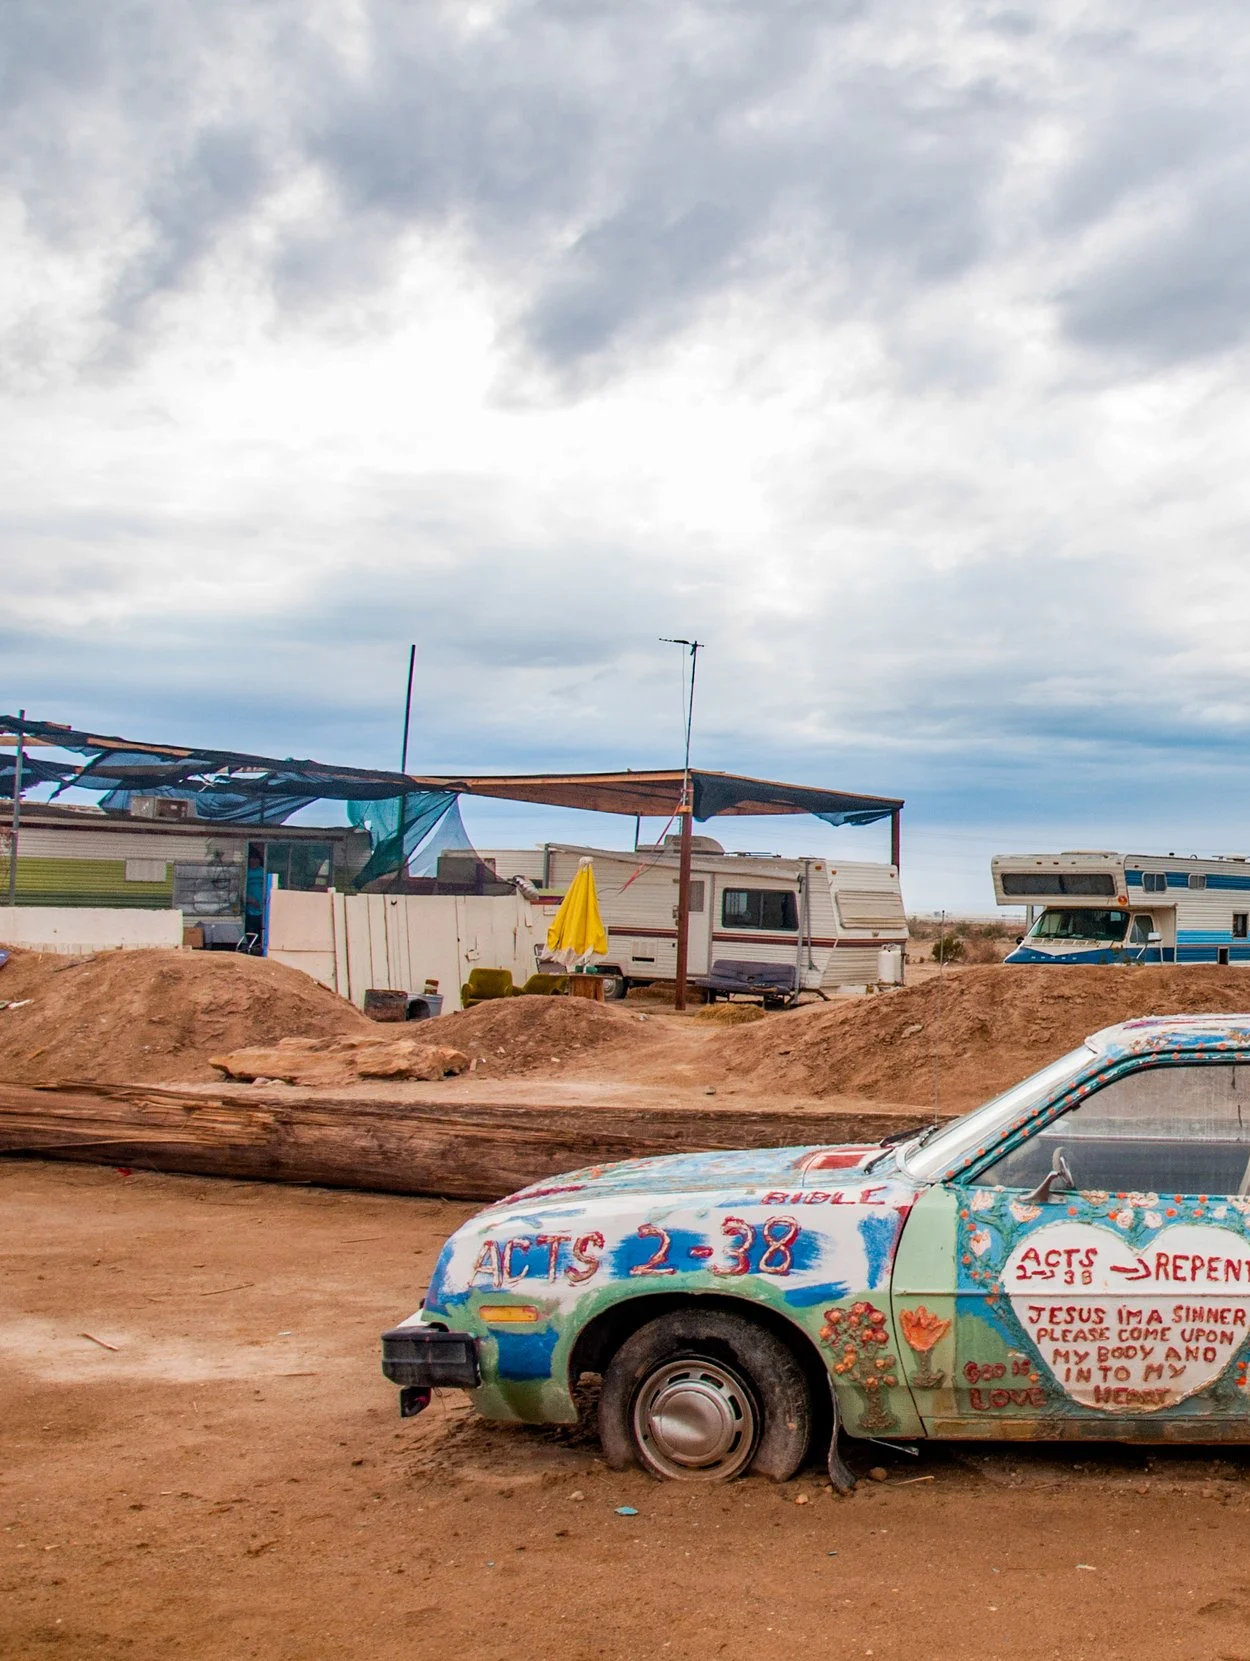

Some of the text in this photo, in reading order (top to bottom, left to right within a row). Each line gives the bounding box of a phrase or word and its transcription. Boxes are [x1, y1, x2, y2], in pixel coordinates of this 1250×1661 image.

[759, 1185, 887, 1206] BIBLE
[467, 1231, 605, 1288] ACTS
[1020, 1247, 1098, 1268] ACTS
[1028, 1305, 1106, 1325] JESUS
[1172, 1304, 1247, 1327] SINNER
[1036, 1326, 1235, 1346] PLEASE COME UPON
[1052, 1345, 1217, 1366] MY BODY AND
[963, 1359, 1032, 1384] GOD IS
[1143, 1363, 1187, 1383] MY
[969, 1387, 1048, 1411] LOVE
[1093, 1385, 1172, 1406] HEART
